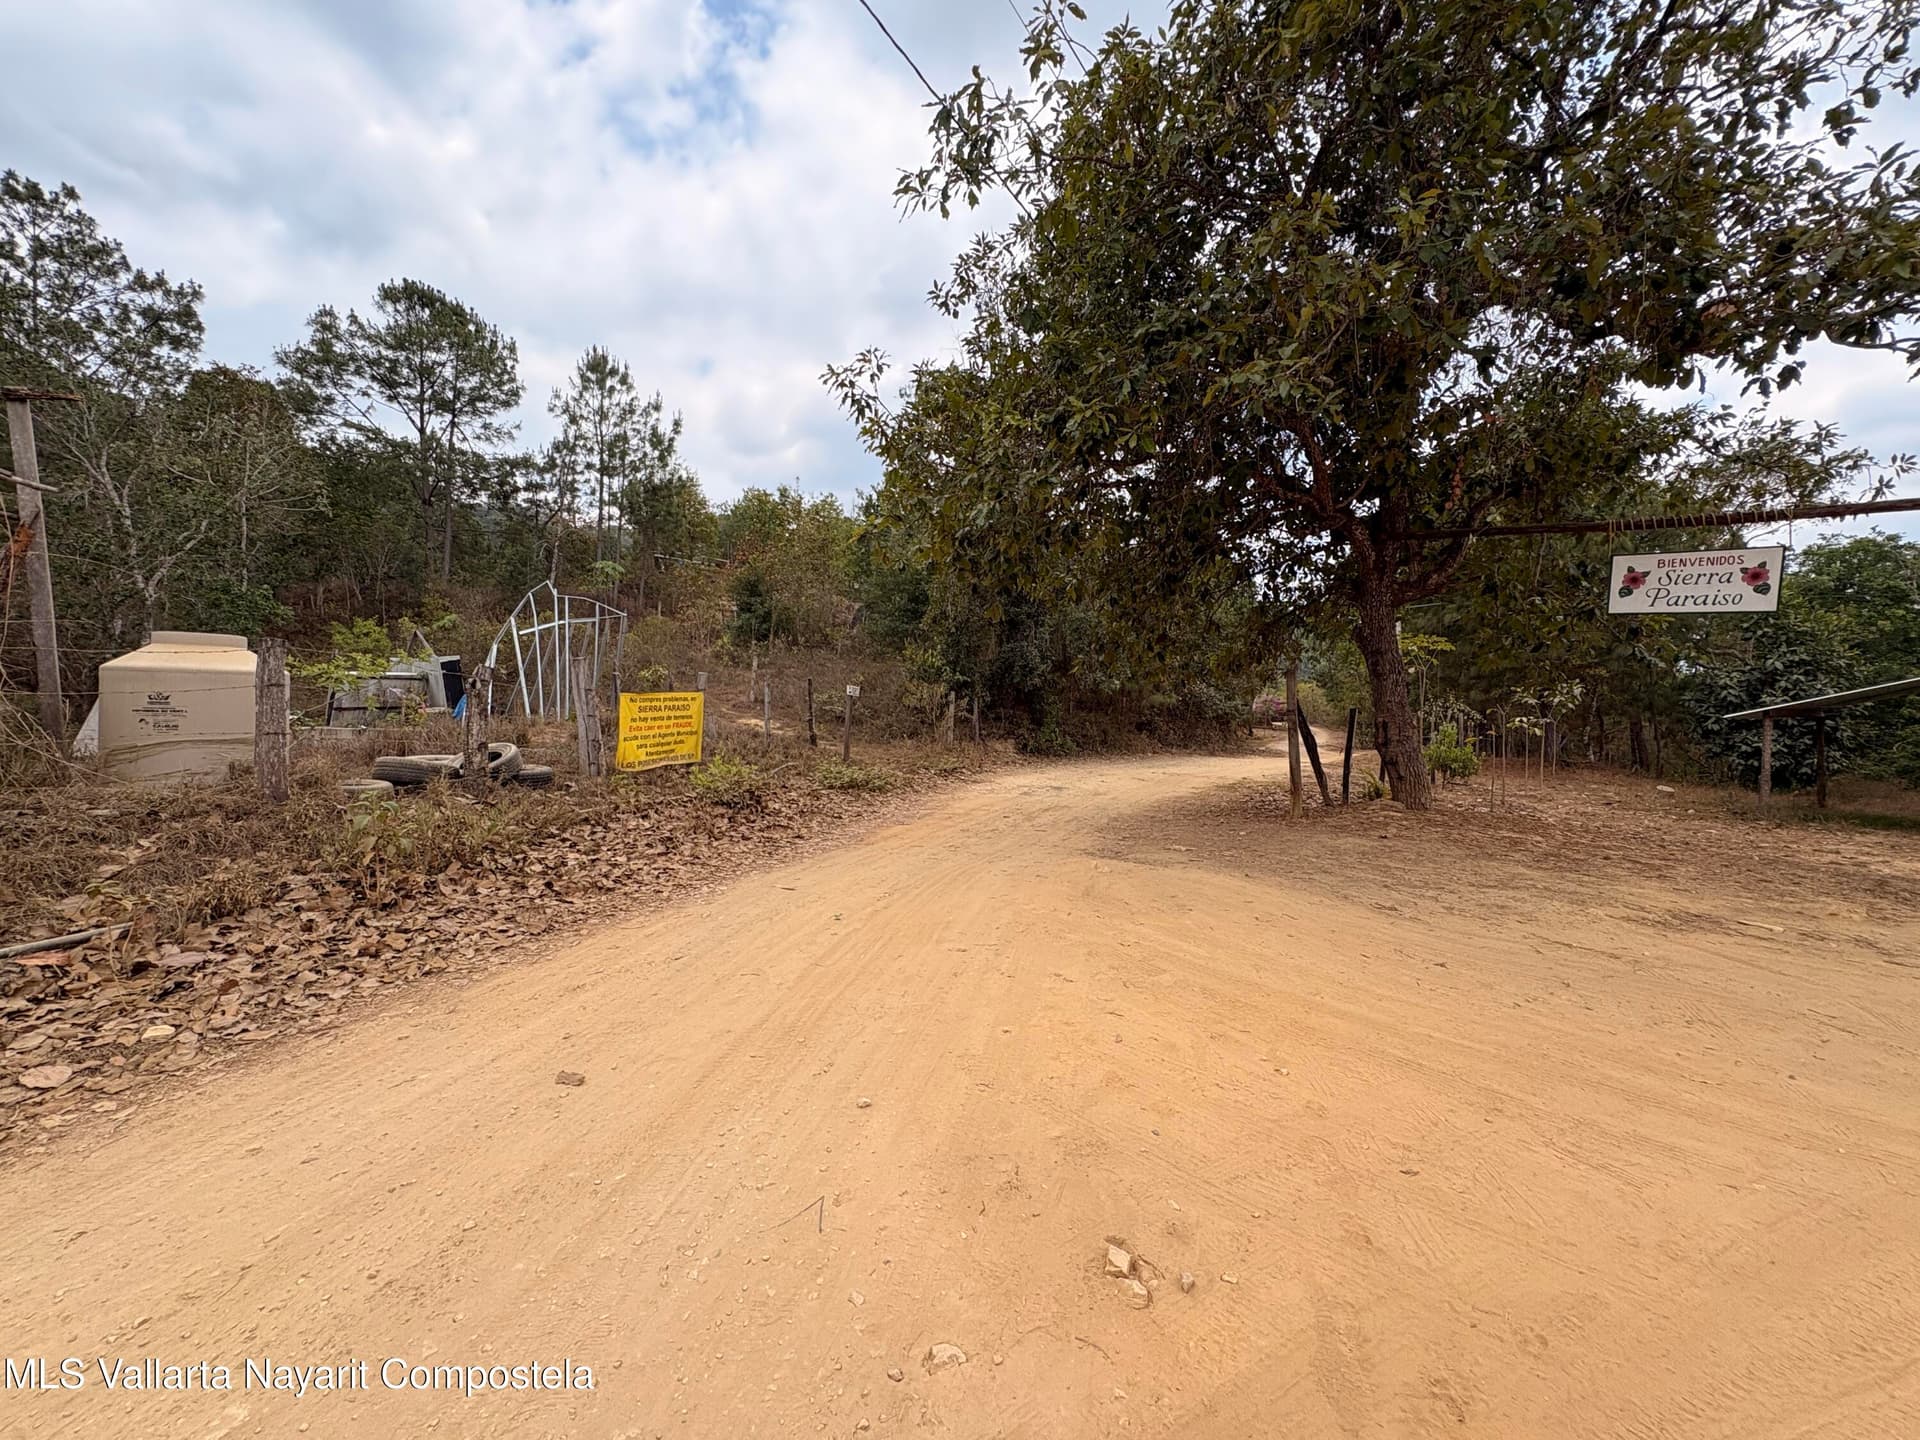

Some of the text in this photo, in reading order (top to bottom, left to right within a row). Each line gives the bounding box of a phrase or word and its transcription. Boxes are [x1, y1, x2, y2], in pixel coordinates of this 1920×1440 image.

[1657, 555, 1745, 569] BIENVENIDOS
[1658, 569, 1734, 587] Sierra
[1645, 588, 1743, 608] Paraiso
[638, 704, 691, 713] SIERRA PARAISO
[638, 716, 649, 724] hay
